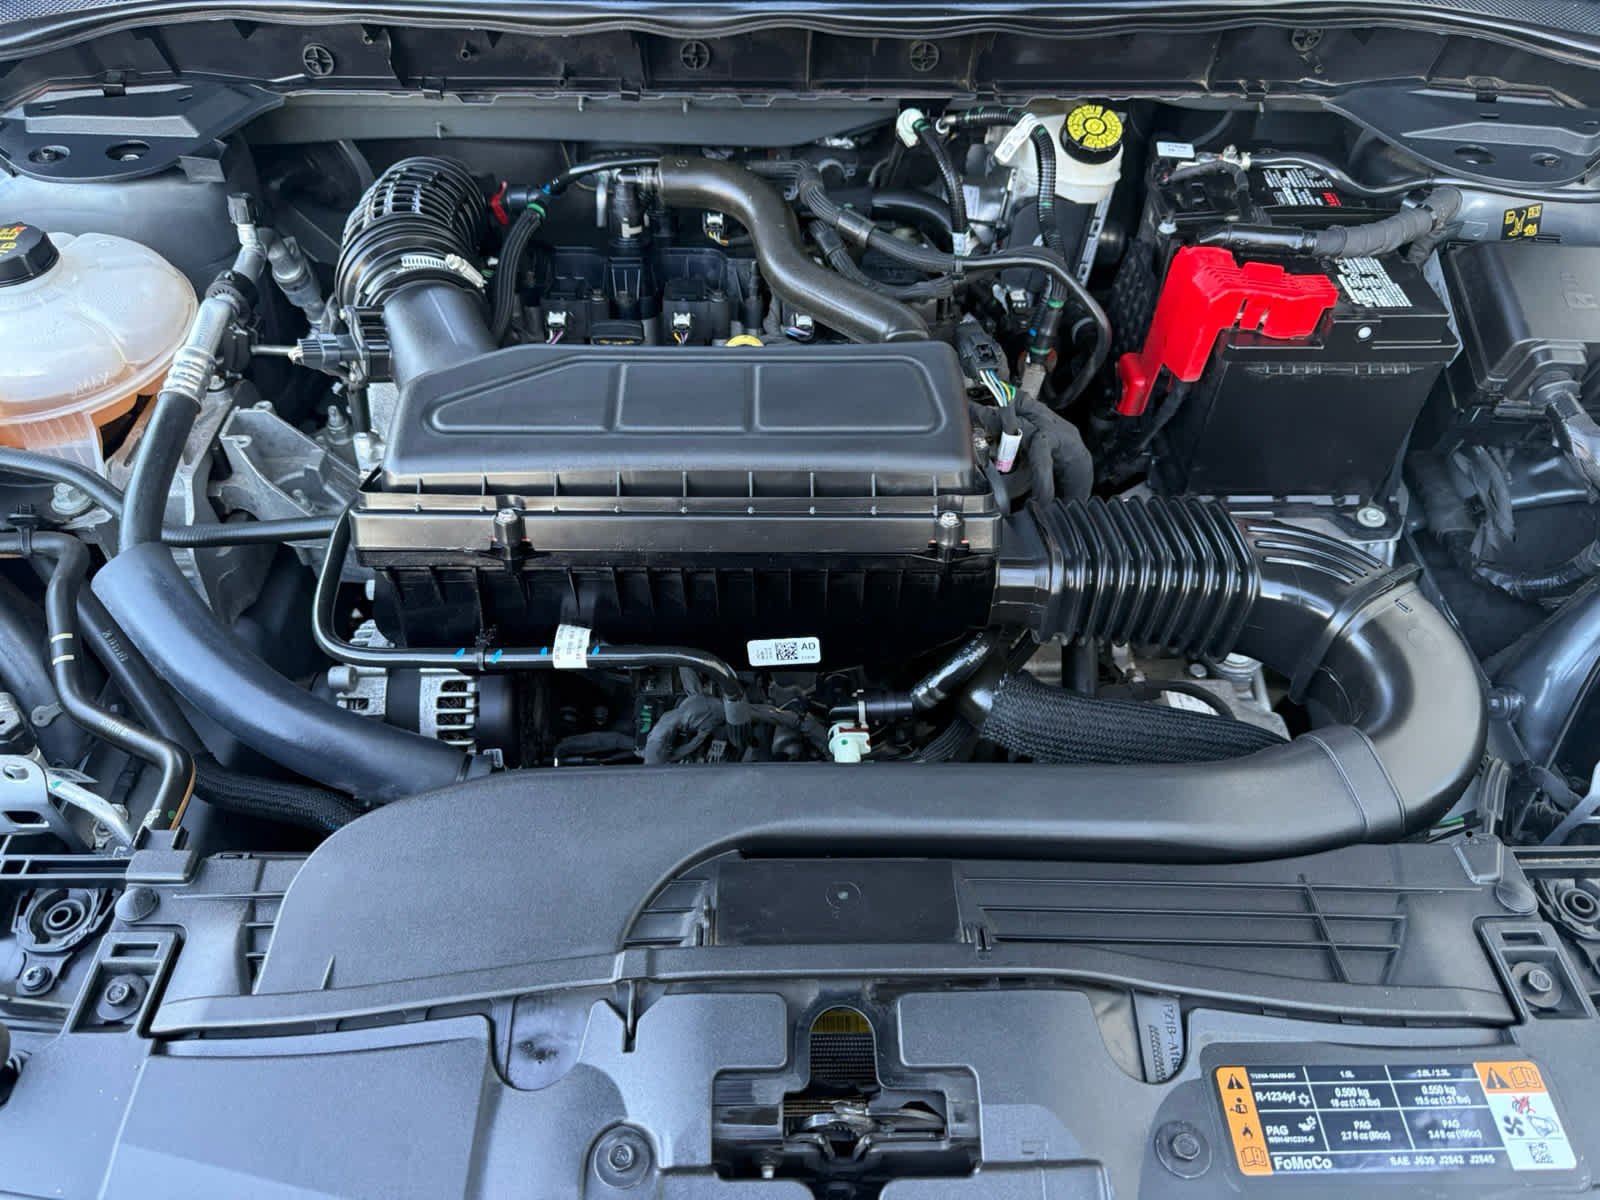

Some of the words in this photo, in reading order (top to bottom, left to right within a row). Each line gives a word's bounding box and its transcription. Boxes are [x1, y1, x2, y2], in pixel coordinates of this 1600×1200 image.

[801, 641, 816, 650] AD
[1334, 1087, 1357, 1098] 0.500
[1357, 1087, 1371, 1099] kg
[1420, 1084, 1444, 1095] 0.550
[1444, 1084, 1457, 1096] kg
[1255, 1090, 1297, 1104] R-1234yf
[1265, 1124, 1289, 1136] PAG
[1353, 1120, 1372, 1130] PAG
[1441, 1119, 1461, 1129] PAG
[1273, 1155, 1333, 1171] FoMoCo
[1389, 1155, 1411, 1166] SAE
